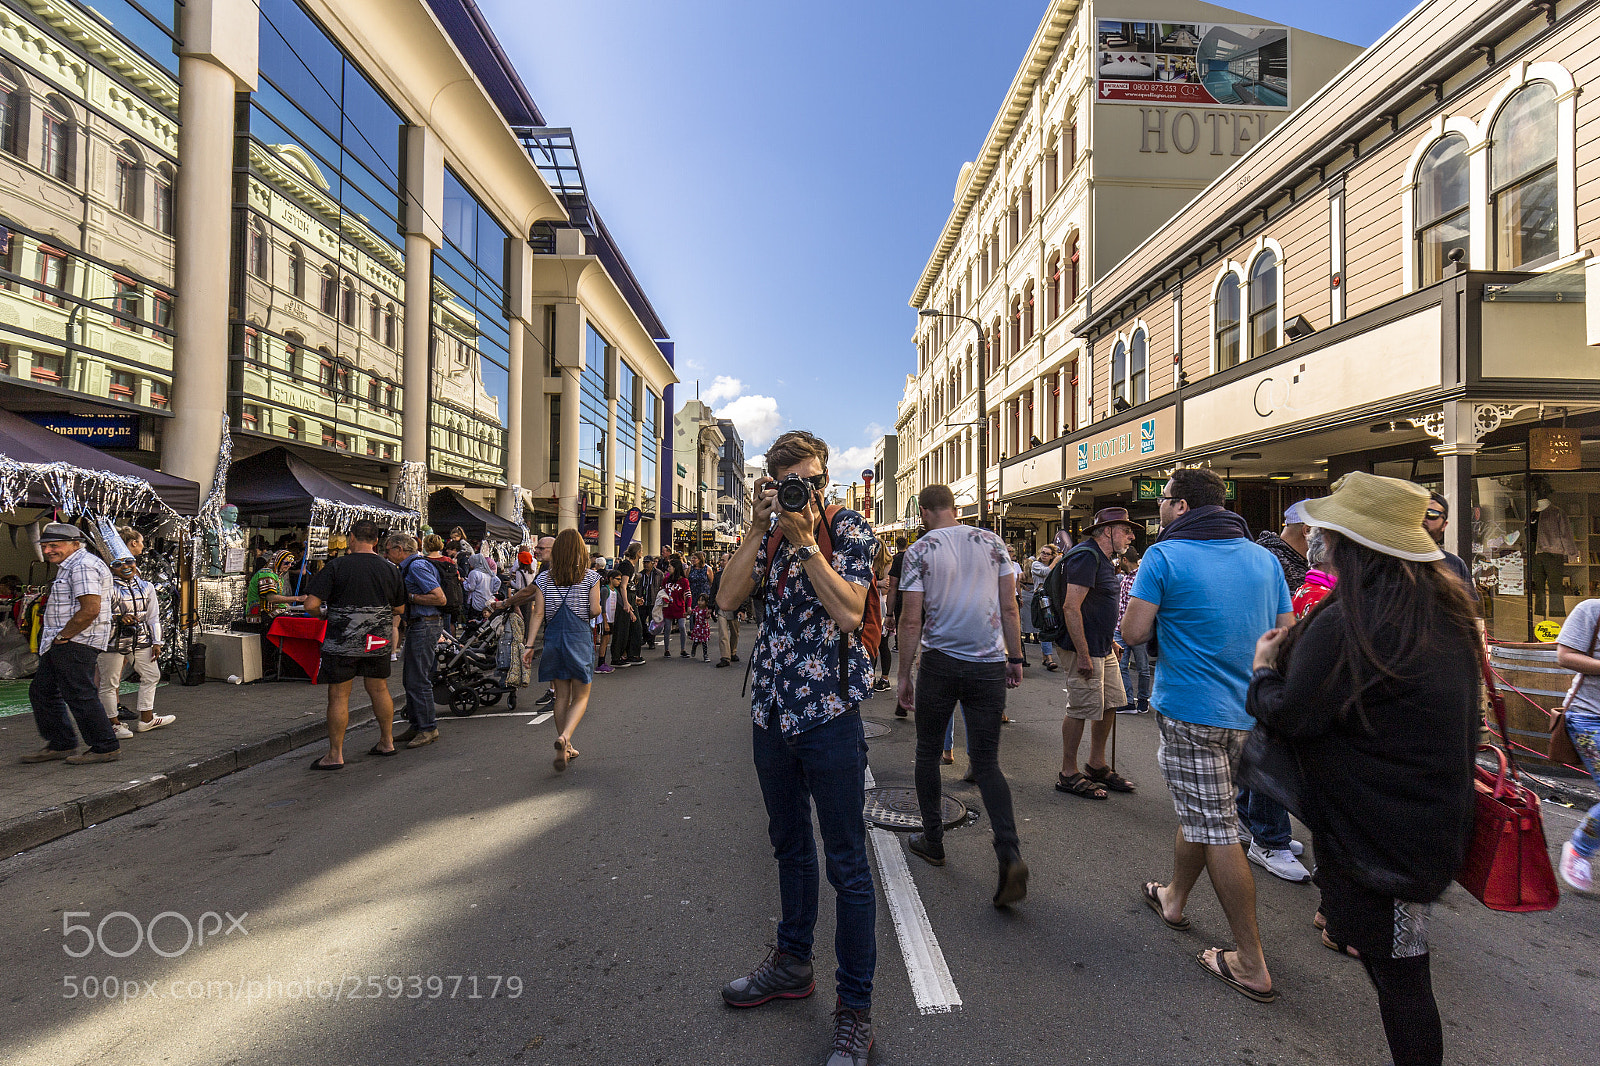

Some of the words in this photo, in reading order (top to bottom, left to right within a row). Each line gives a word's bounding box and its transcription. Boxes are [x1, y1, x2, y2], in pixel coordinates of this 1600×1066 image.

[1132, 83, 1150, 91] 0800
[45, 424, 131, 437] ionarmy.org.nz
[1091, 431, 1135, 462] HOTEL
